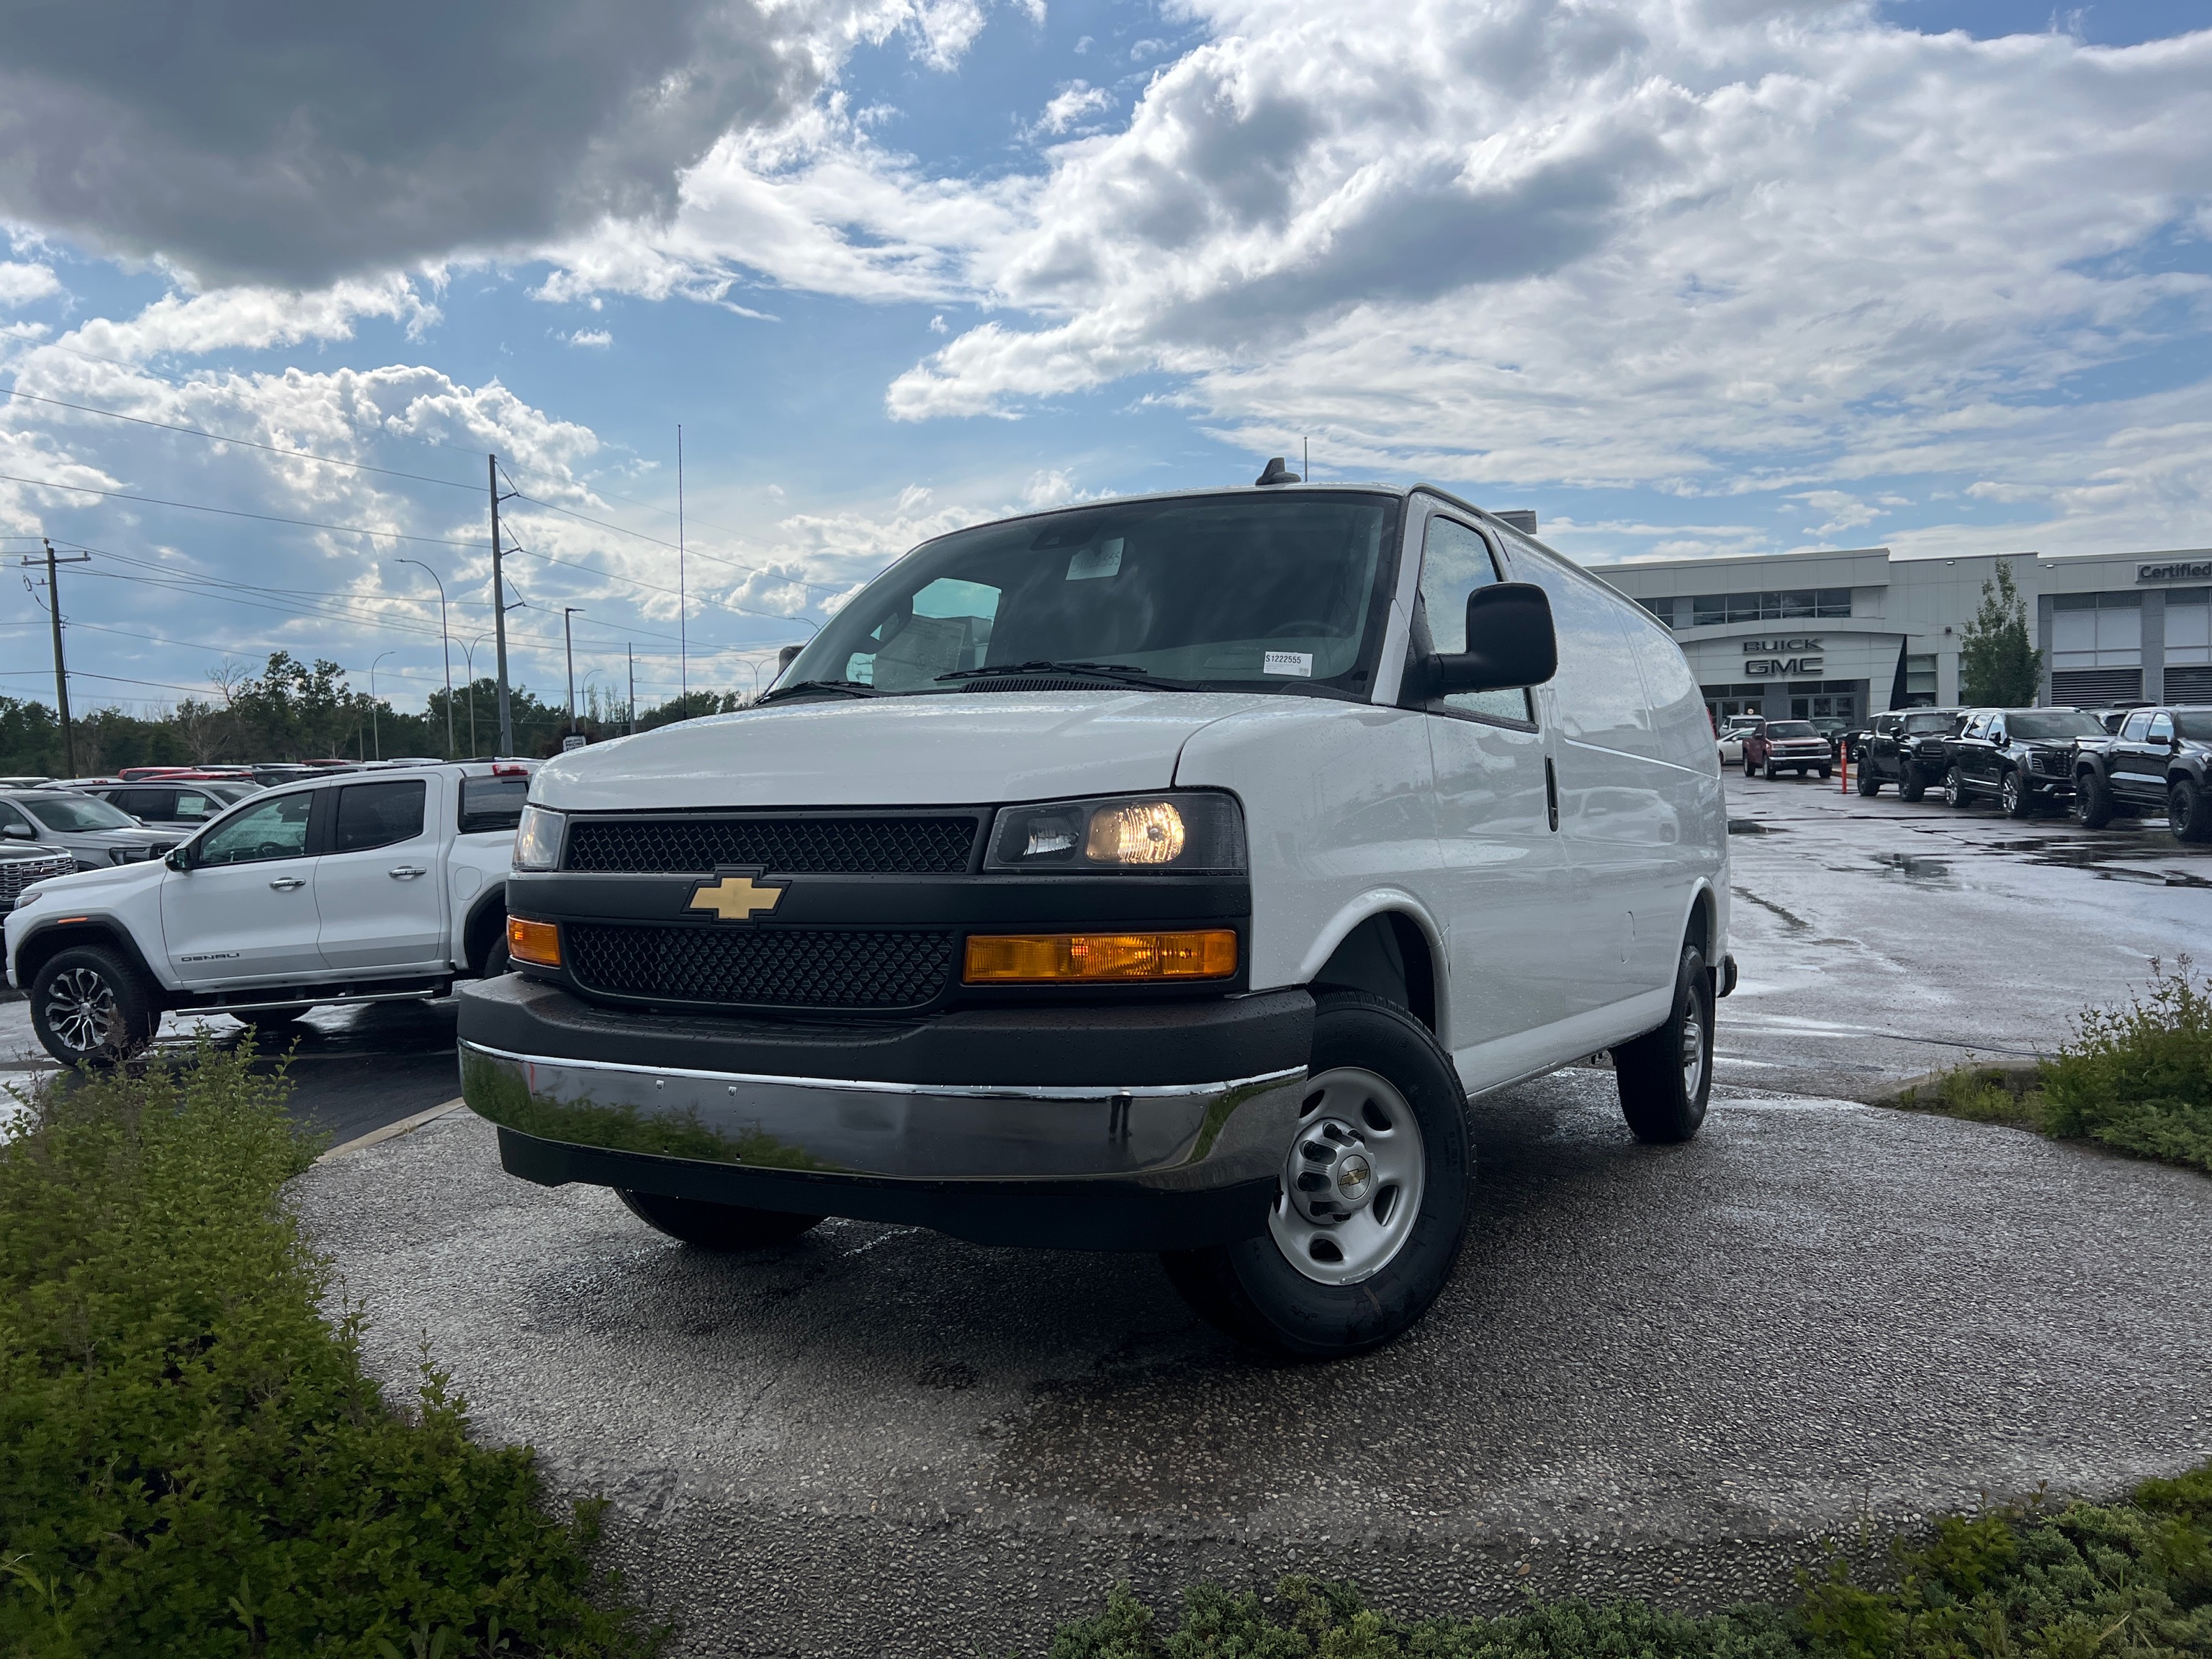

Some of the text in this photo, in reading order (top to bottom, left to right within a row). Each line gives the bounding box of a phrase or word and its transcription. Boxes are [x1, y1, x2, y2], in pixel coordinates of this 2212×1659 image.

[2141, 562, 2212, 577] Certified
[1743, 639, 1825, 652] BUICK
[1265, 655, 1302, 664] S1222555
[1745, 657, 1824, 675] GMC
[181, 952, 240, 962] DENALI
